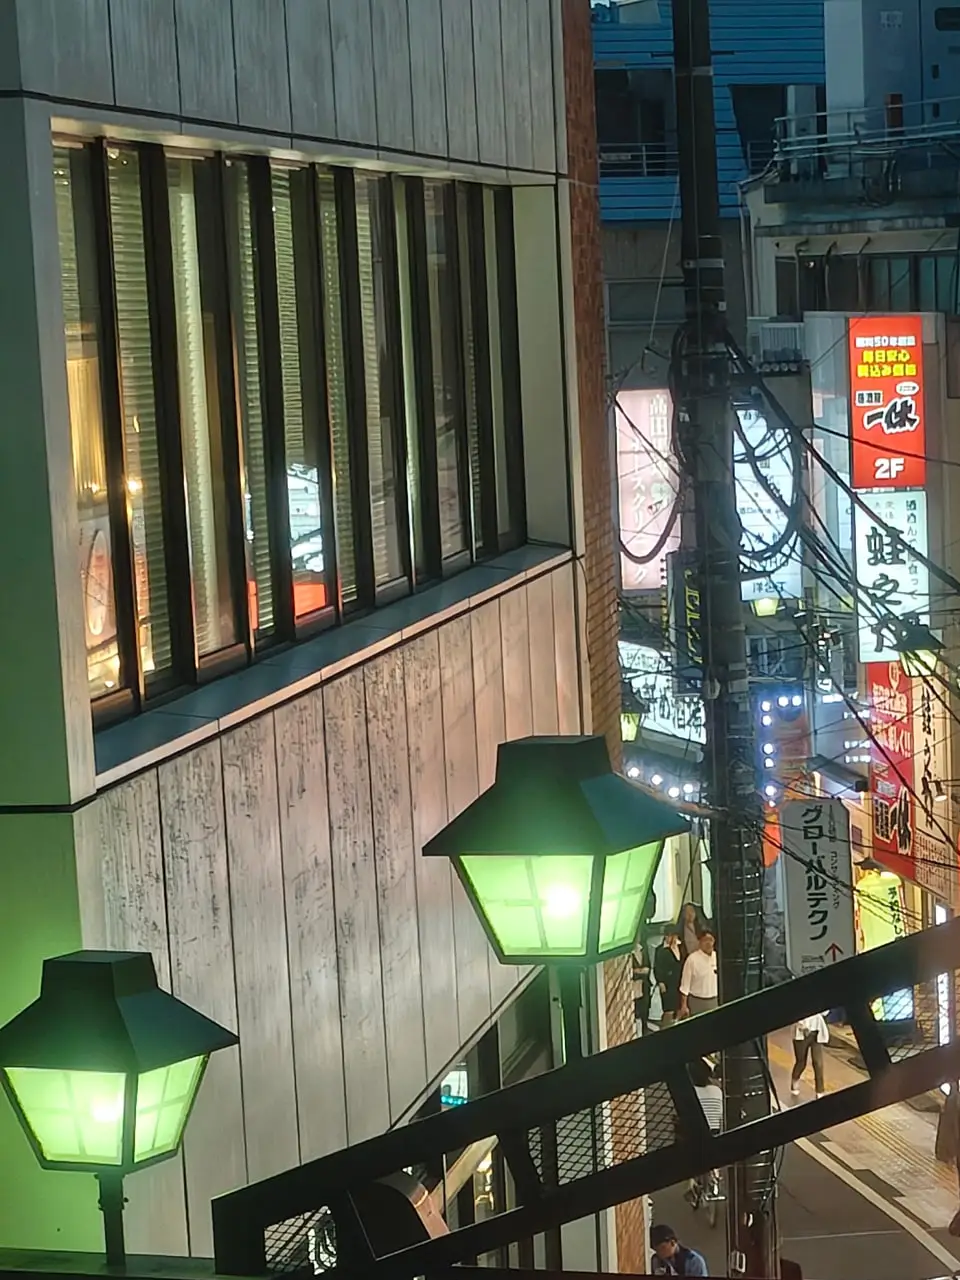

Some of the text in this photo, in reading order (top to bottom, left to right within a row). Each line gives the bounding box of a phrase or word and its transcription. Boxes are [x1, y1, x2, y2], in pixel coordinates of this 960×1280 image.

[874, 457, 906, 480] 2F
[801, 805, 829, 941] グローバルテクノ
